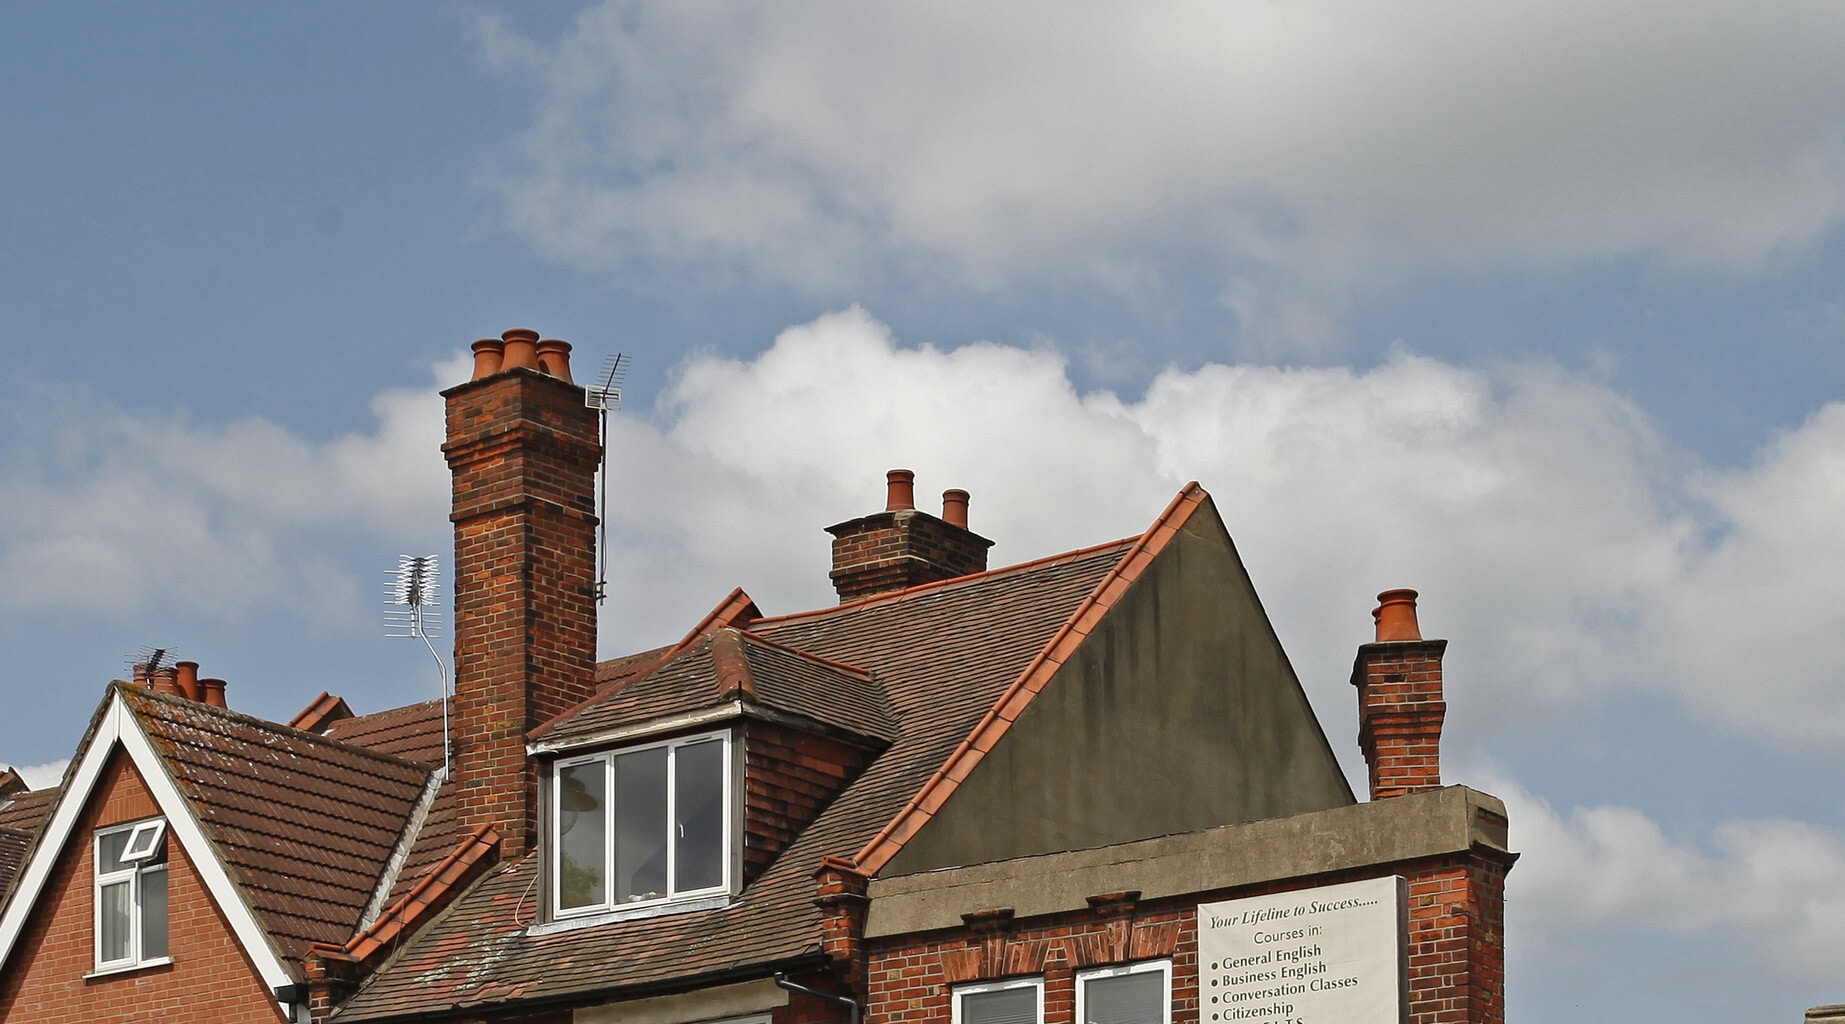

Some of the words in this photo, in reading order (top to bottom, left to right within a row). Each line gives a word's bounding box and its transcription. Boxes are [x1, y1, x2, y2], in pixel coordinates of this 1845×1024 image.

[1210, 916, 1238, 929] Your
[1242, 908, 1290, 926] Lifeline
[1294, 906, 1305, 916] to
[1254, 928, 1304, 944] Courses
[1308, 925, 1322, 936] in:
[1222, 951, 1271, 970] General
[1276, 944, 1321, 963] English
[1223, 971, 1276, 986] Business
[1282, 961, 1326, 980] English
[1222, 984, 1305, 1003] Conversation
[1310, 976, 1358, 992] Classes
[1223, 1002, 1294, 1020] Citizenship
